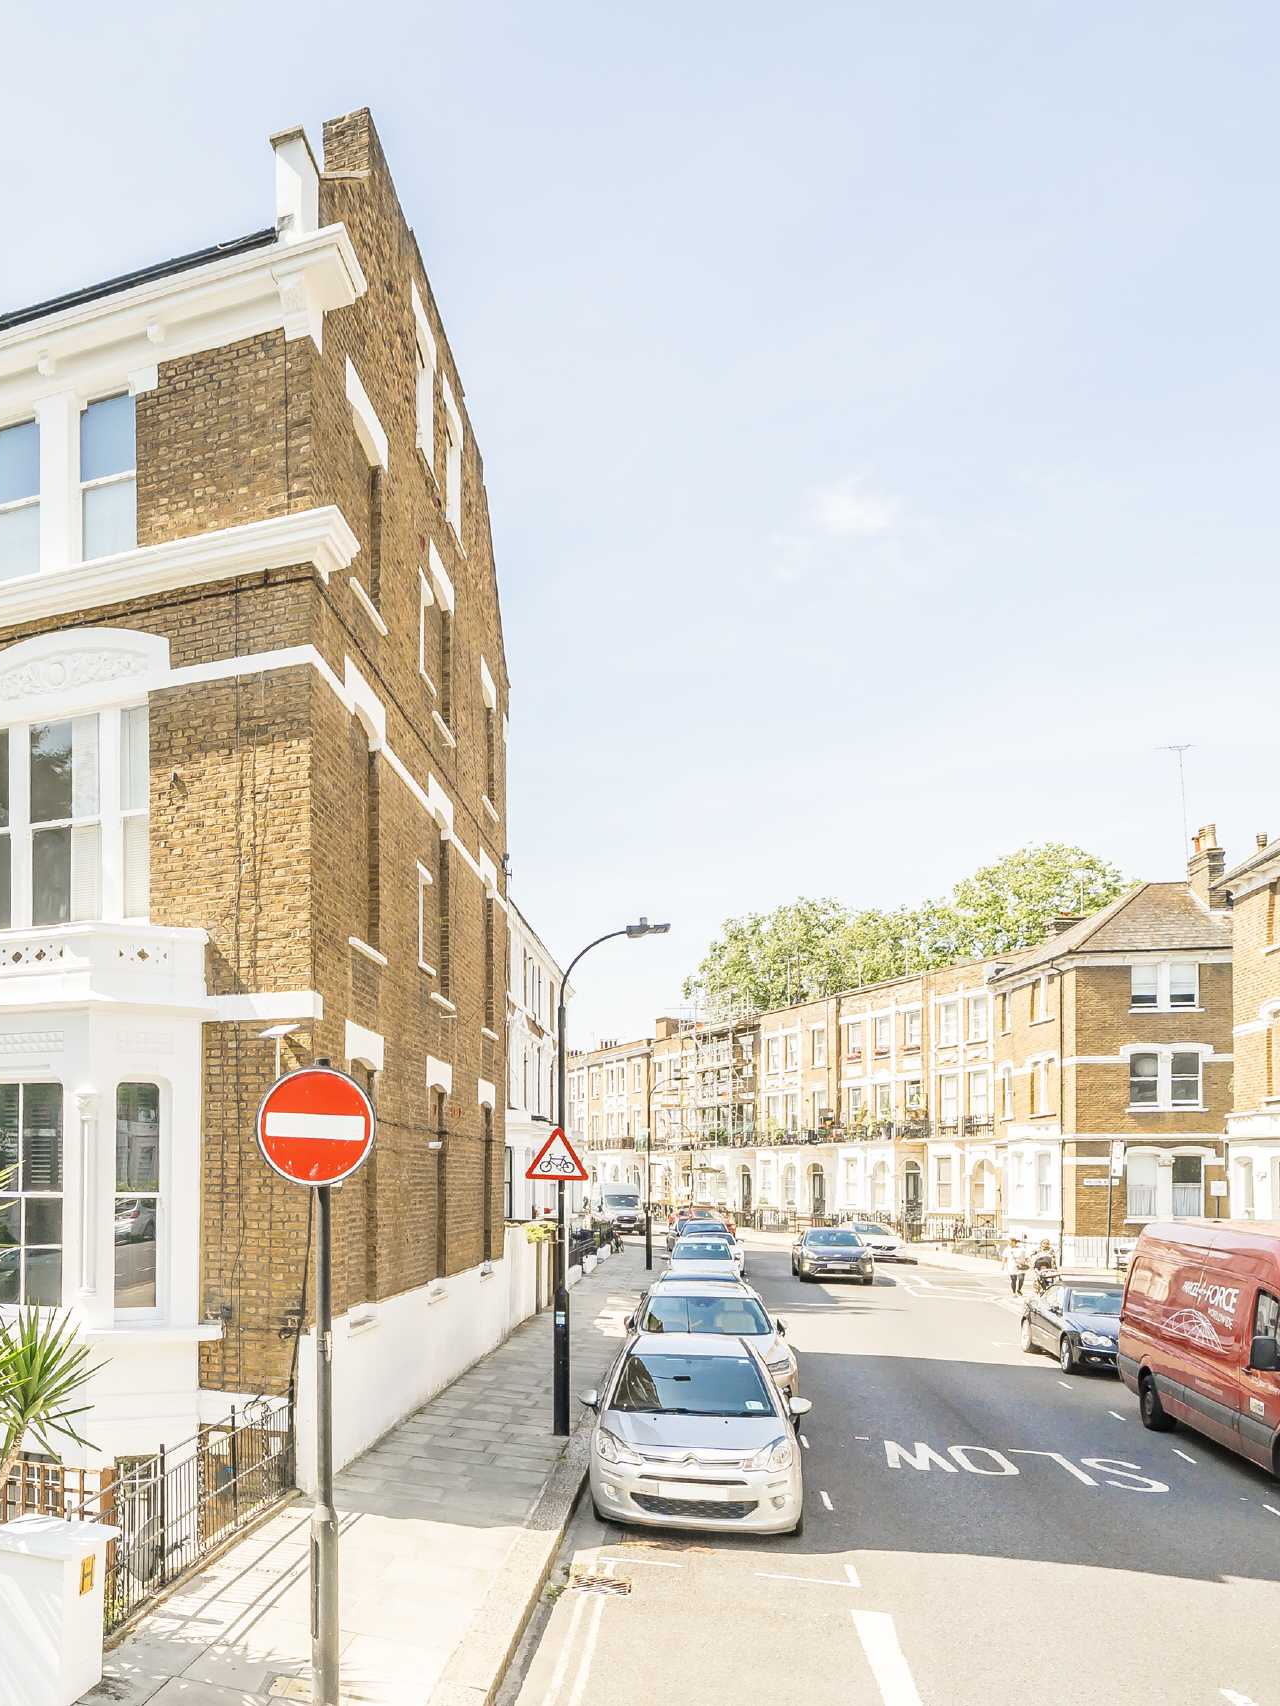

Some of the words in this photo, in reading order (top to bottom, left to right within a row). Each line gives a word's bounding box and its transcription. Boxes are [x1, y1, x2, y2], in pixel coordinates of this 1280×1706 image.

[1205, 1284, 1240, 1314] FORCE
[883, 1439, 1170, 1493] SLOW
[81, 1557, 94, 1592] H
